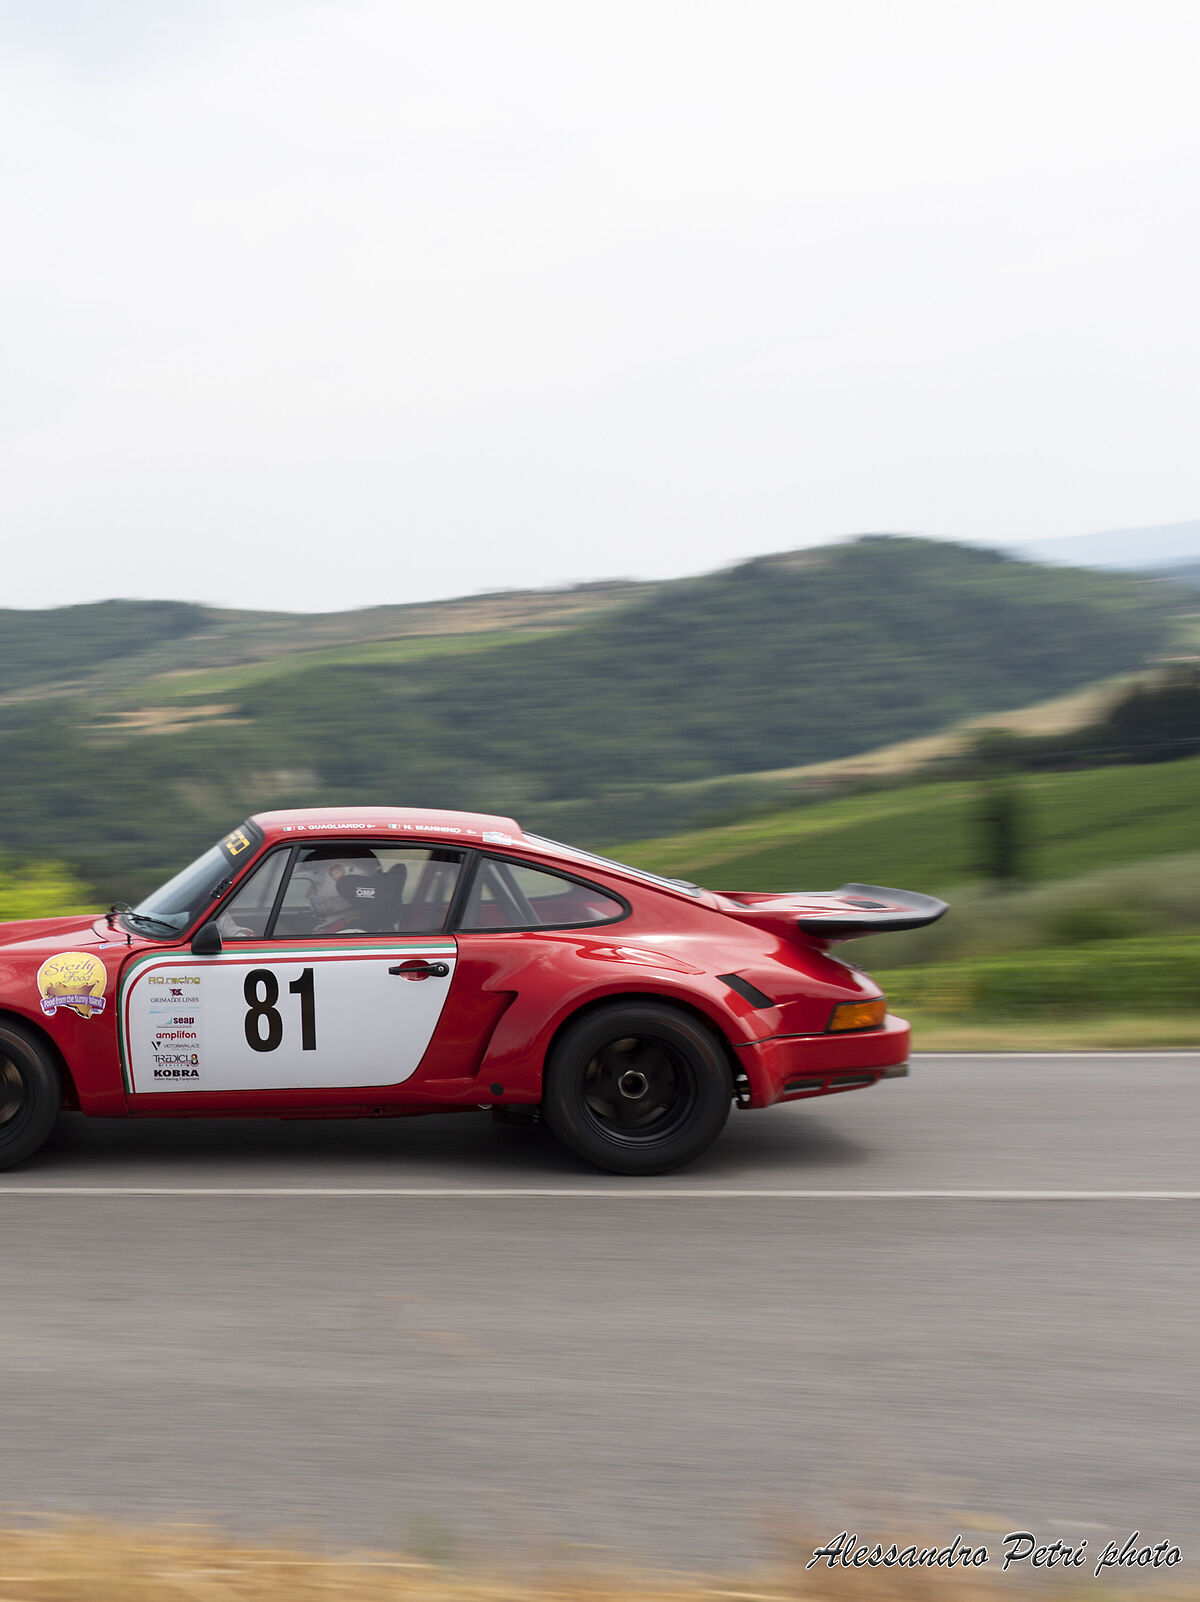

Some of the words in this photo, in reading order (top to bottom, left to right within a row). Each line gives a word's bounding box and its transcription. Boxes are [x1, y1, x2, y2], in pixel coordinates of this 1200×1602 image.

[45, 958, 96, 976] Sicily
[62, 971, 93, 983] Food
[244, 968, 316, 1052] 81
[173, 1017, 194, 1025] seap
[155, 1031, 197, 1040] amplifon
[153, 1069, 199, 1077] KOBRA
